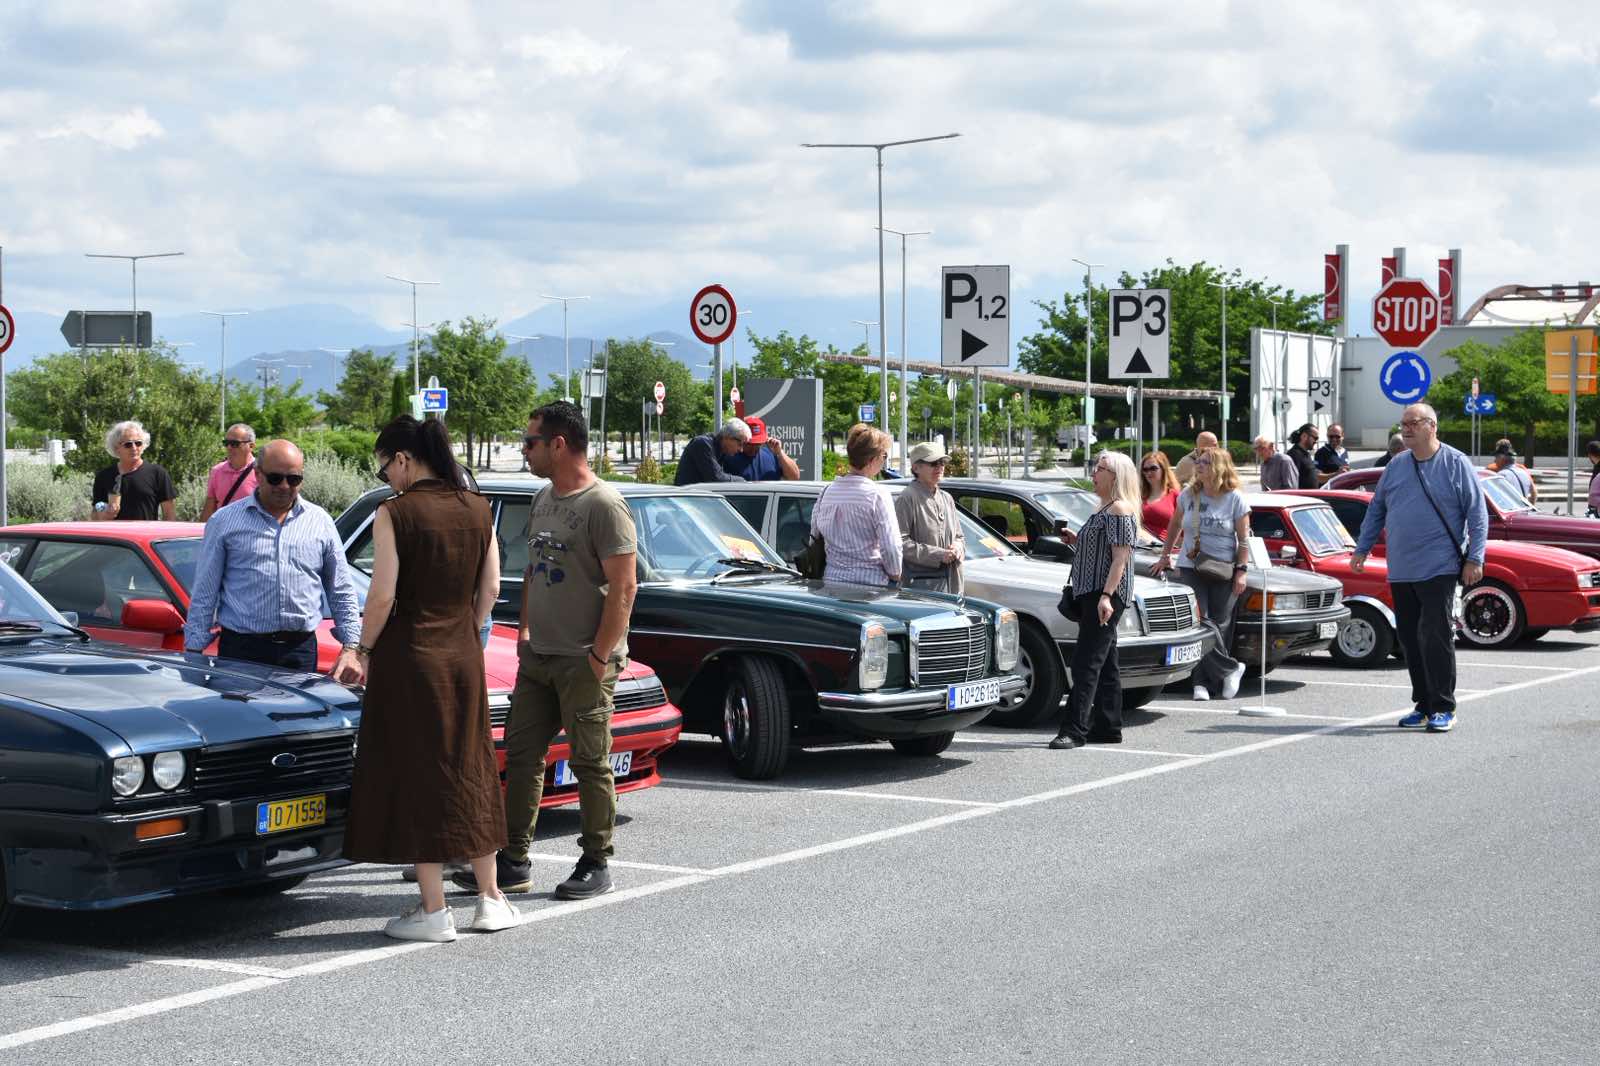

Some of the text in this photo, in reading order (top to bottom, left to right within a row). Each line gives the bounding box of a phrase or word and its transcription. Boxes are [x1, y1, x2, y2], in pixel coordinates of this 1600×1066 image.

[699, 304, 728, 326] 30
[1113, 295, 1166, 336] P3
[1376, 296, 1436, 332] STOP
[1308, 379, 1331, 397] P3
[766, 424, 805, 440] FASHION
[783, 441, 804, 456] CITY
